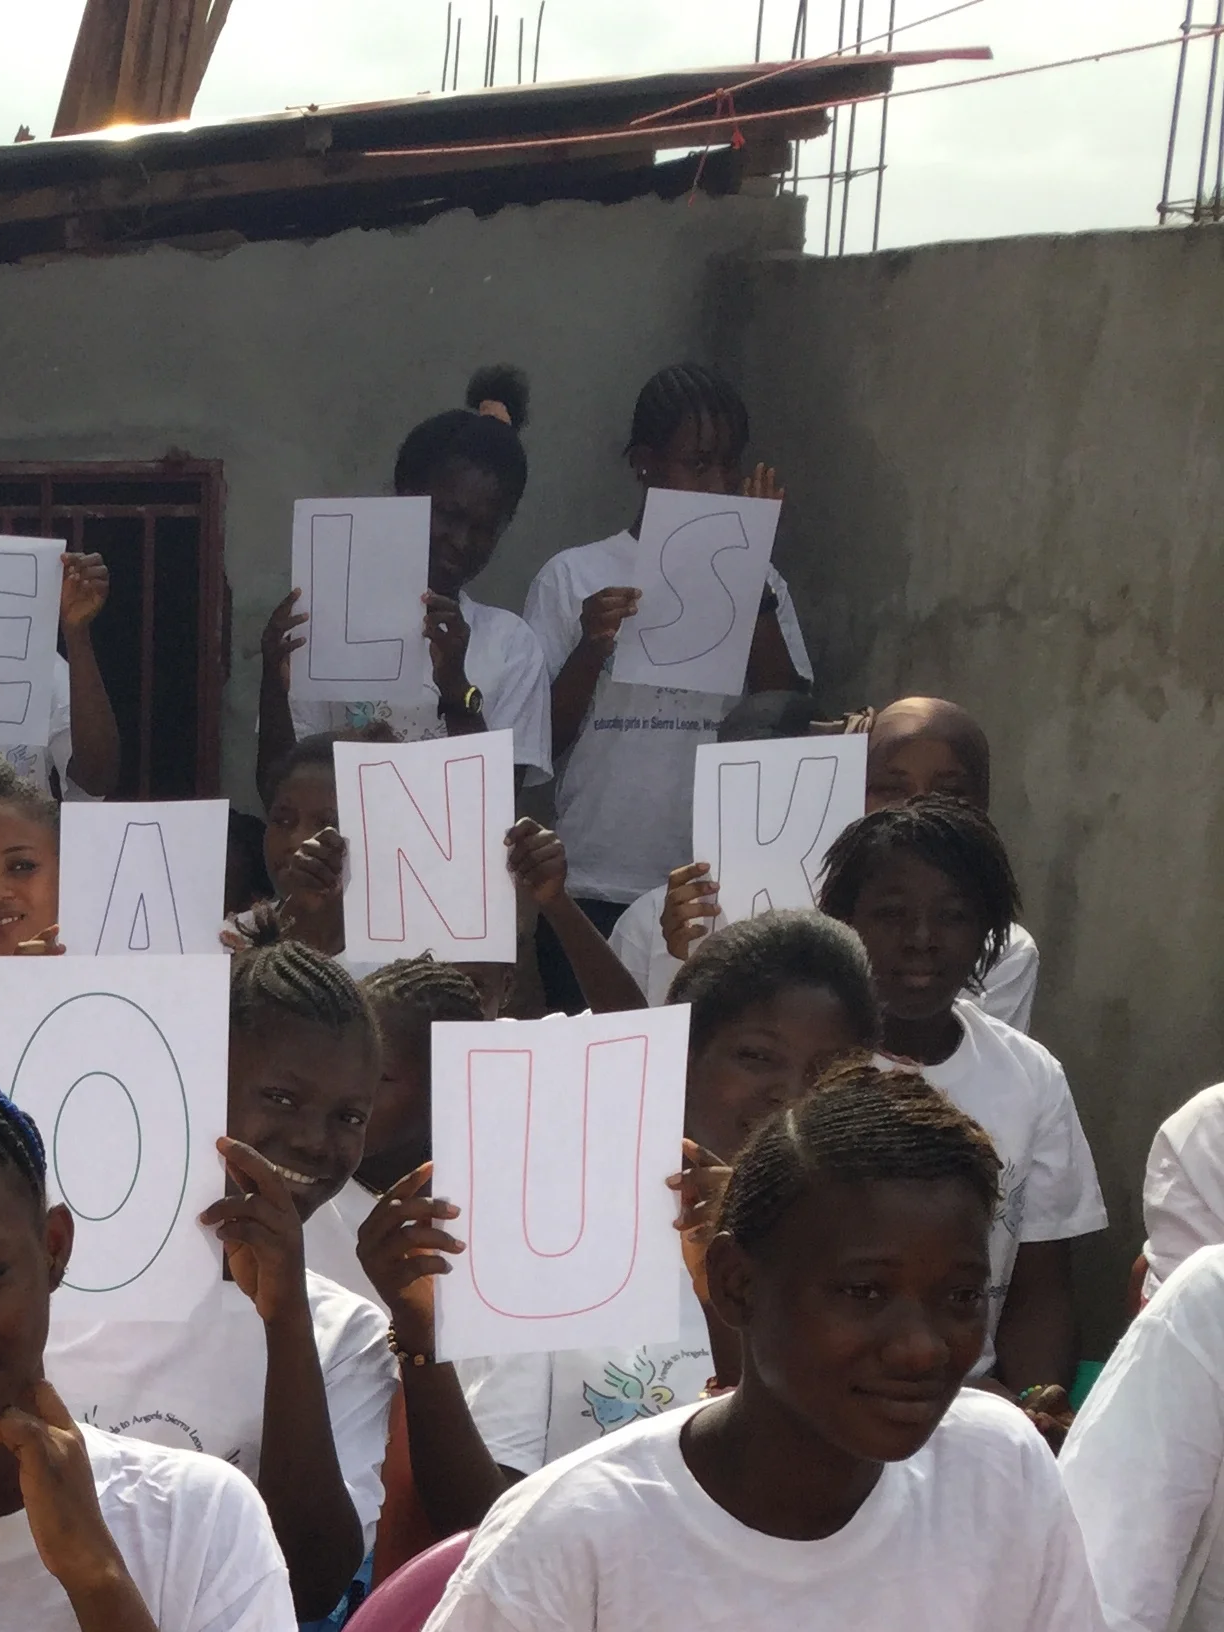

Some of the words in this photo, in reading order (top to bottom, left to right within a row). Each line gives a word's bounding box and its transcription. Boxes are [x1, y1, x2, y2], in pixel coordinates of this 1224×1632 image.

[308, 513, 404, 682] L
[637, 510, 749, 667] S
[94, 821, 184, 955] A
[358, 755, 489, 943] N
[712, 756, 839, 933] K
[9, 991, 190, 1293] O
[467, 1034, 650, 1320] U
[164, 1412, 190, 1433] Sierra
[189, 1429, 204, 1452] Leon
